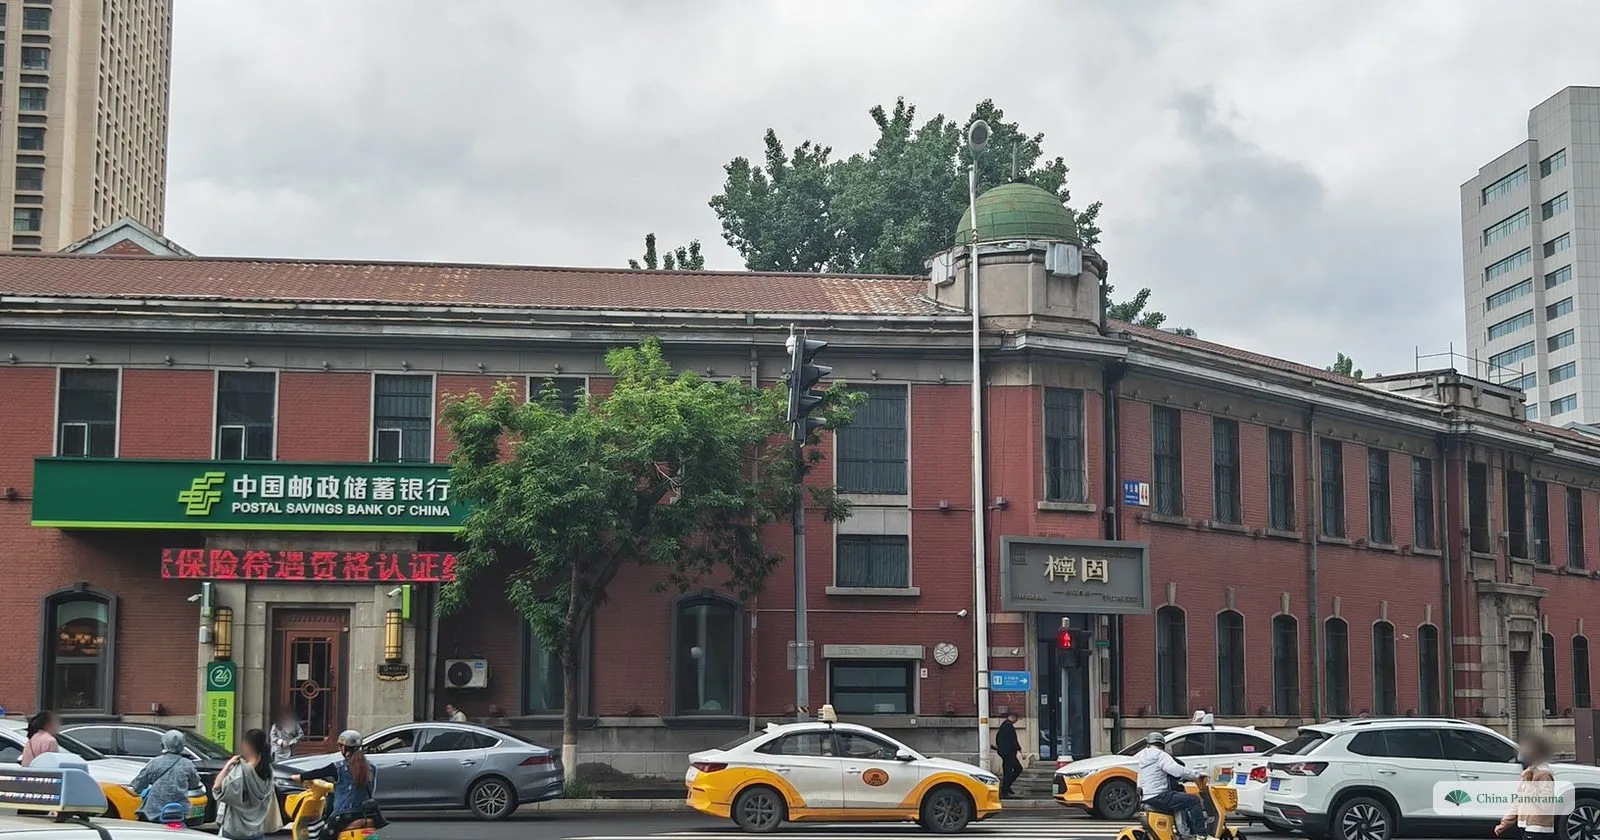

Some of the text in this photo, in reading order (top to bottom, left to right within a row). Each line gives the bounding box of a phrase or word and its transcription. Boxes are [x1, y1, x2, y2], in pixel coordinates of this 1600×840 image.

[232, 474, 450, 501] 中国邮政储蓄银行
[231, 502, 451, 517] POSTAL SAVINGS BANK OF CHINA
[215, 669, 229, 683] 24
